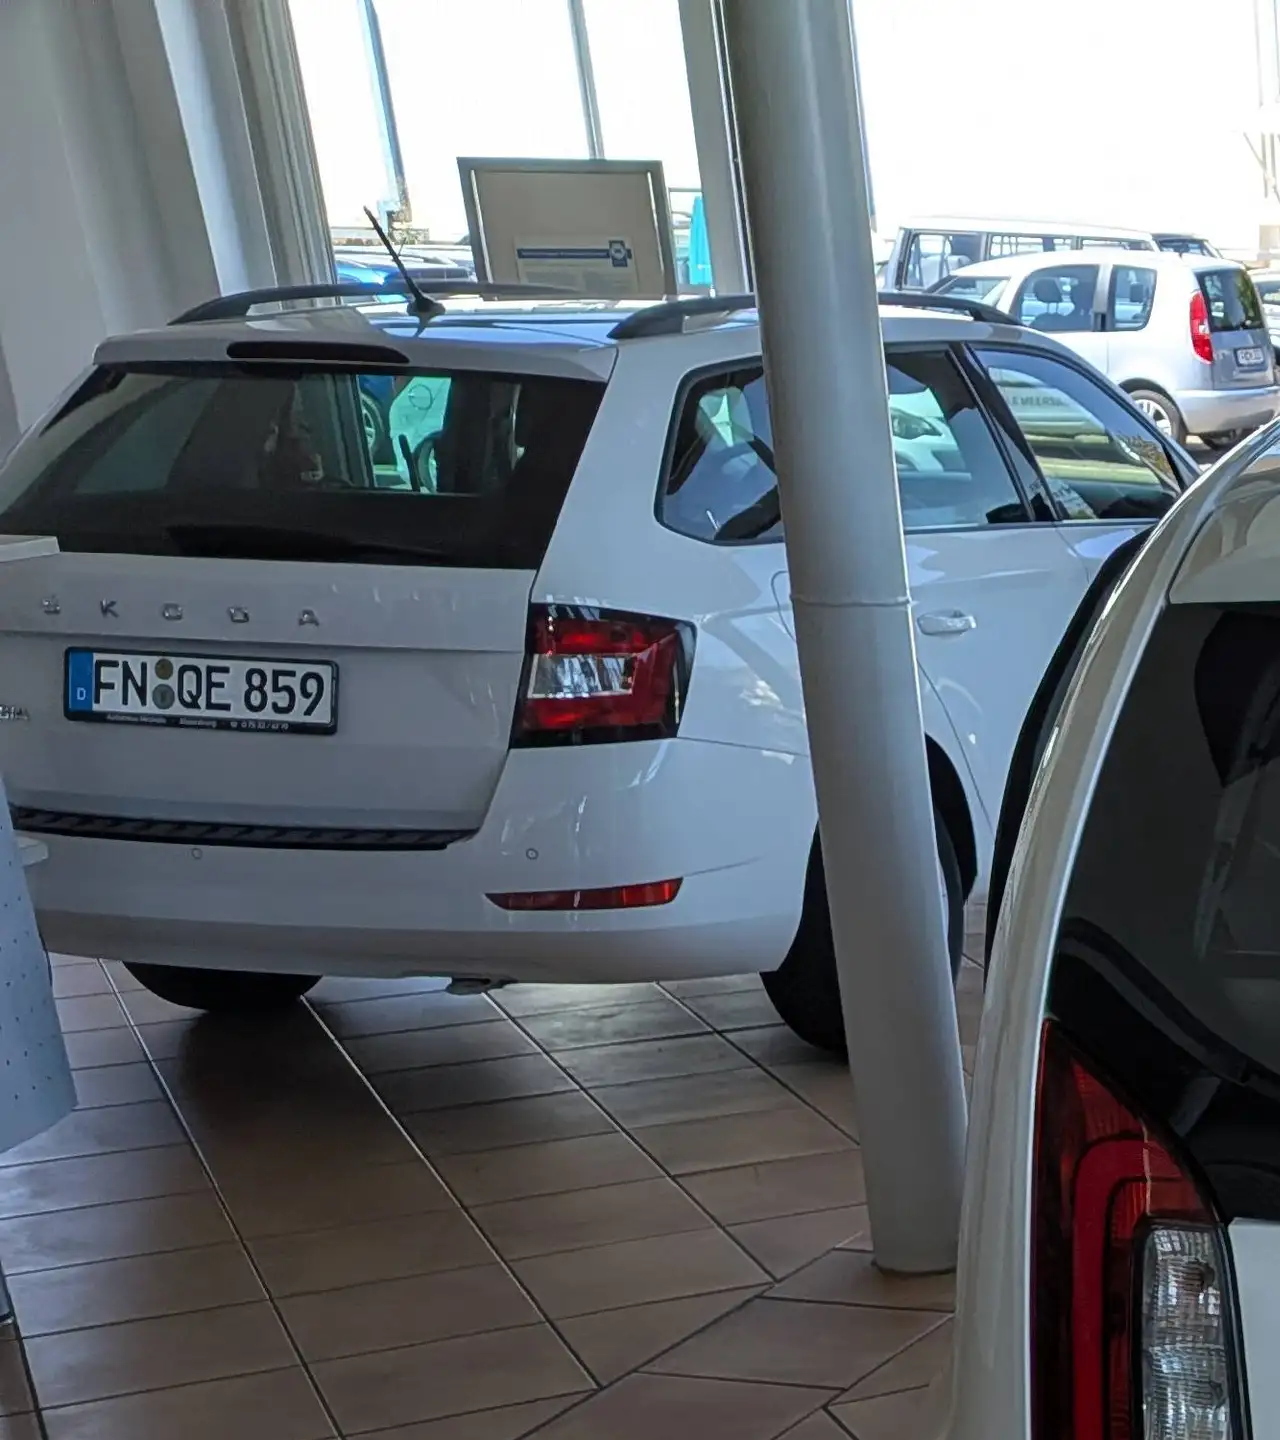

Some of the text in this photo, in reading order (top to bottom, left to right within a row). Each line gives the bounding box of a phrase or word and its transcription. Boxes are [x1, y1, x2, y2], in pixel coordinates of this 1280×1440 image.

[76, 686, 87, 701] D
[93, 659, 325, 717] FN QE 859
